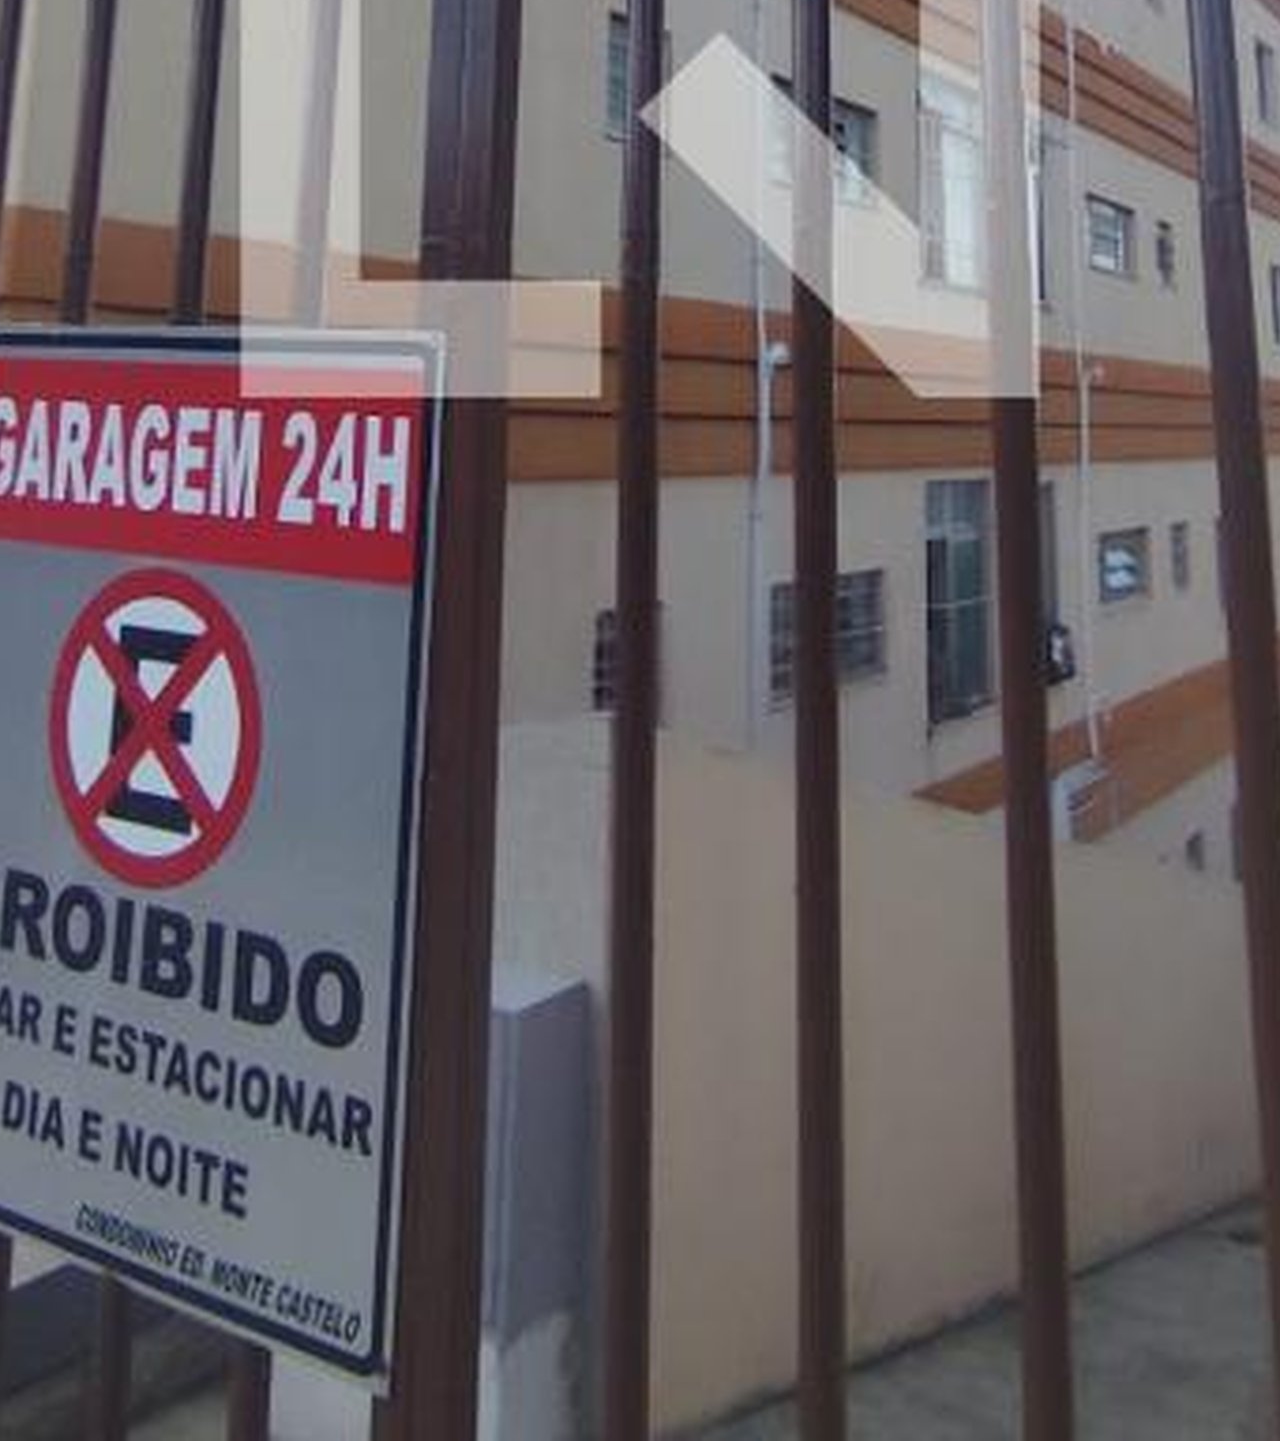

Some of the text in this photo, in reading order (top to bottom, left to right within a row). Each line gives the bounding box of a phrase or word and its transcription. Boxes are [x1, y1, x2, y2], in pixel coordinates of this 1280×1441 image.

[276, 411, 412, 533] 24H
[52, 1004, 78, 1057] E
[88, 1014, 374, 1157] ESTACIONAR
[1, 1079, 249, 1219] DIA E NOITE
[210, 1259, 274, 1308] MONTE
[274, 1284, 362, 1345] CASTELO
